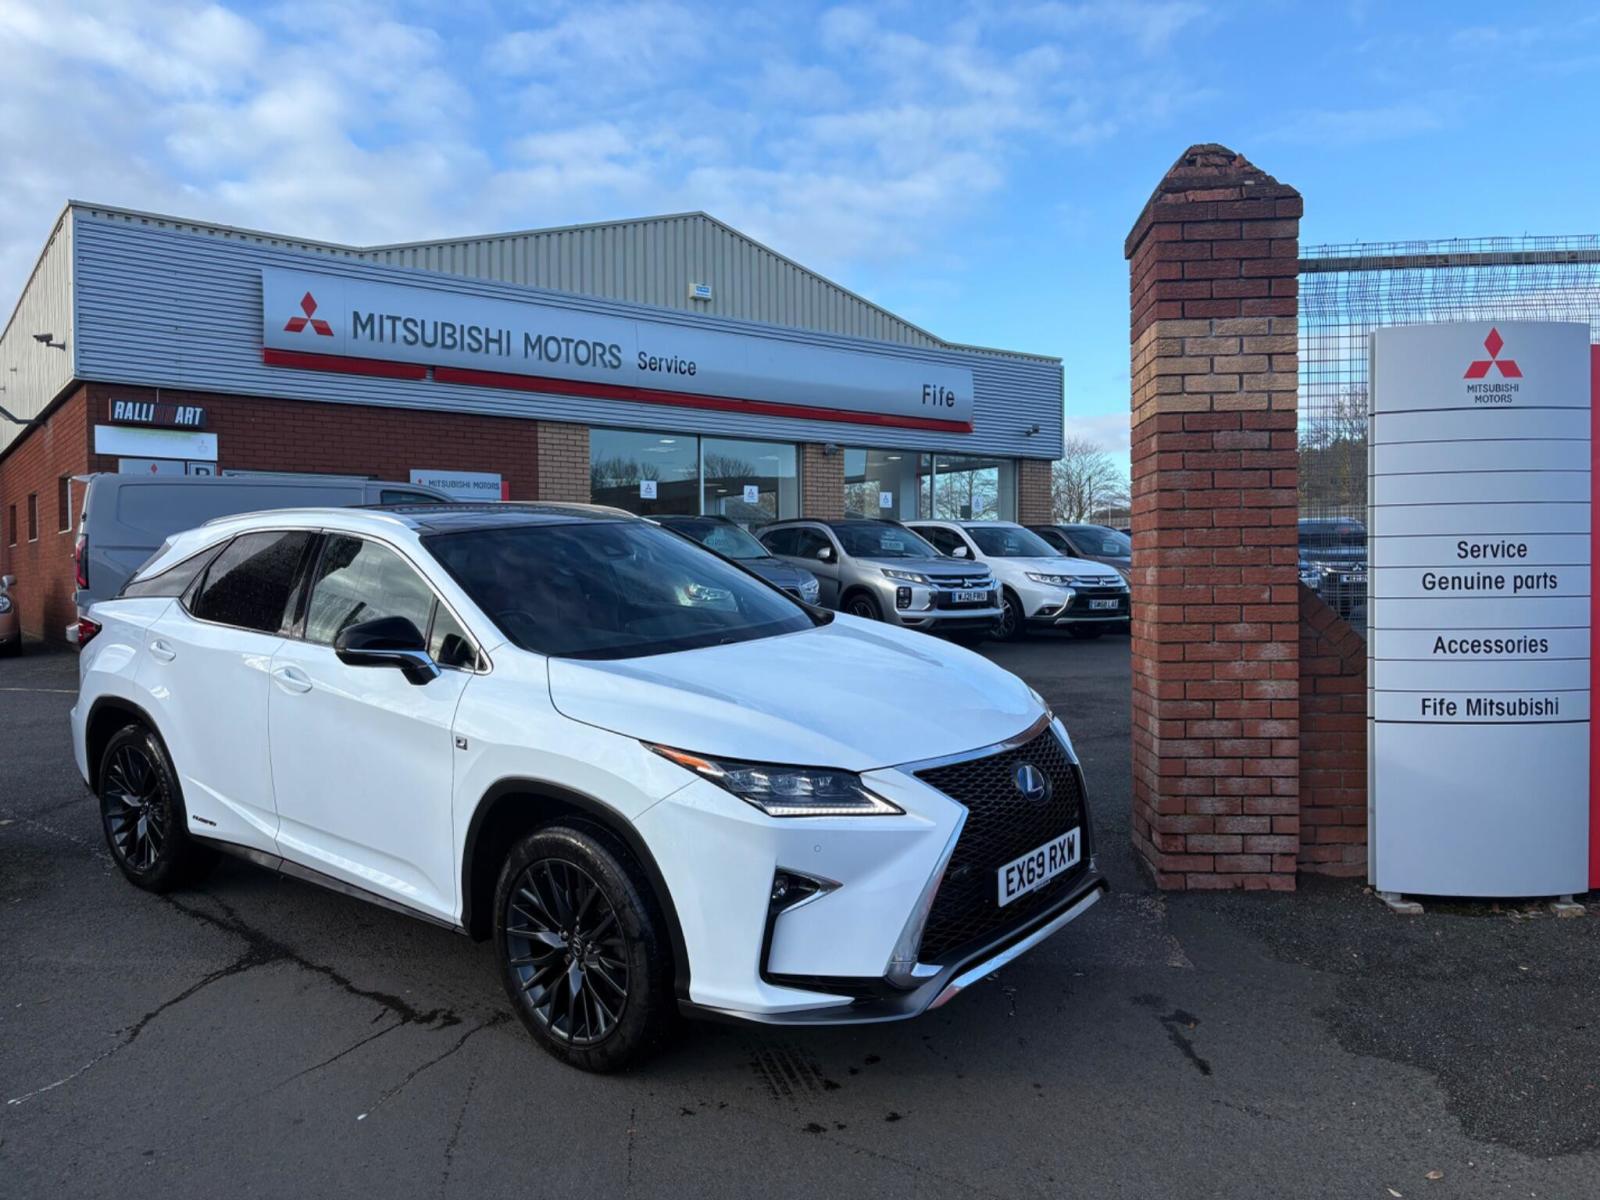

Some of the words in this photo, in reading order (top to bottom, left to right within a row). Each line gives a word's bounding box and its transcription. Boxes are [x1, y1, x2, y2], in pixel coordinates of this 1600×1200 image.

[351, 310, 511, 357] MITSUBISHI
[523, 332, 622, 369] MOTORS
[637, 351, 697, 376] Service
[922, 384, 955, 407] Fife
[1466, 383, 1519, 393] MITSUBISHI
[1474, 394, 1512, 403] MOTORS
[113, 400, 154, 421] RALLI
[174, 406, 203, 425] ART
[428, 479, 471, 488] MITSUBISHI
[473, 482, 500, 490] MOTORS
[1456, 540, 1528, 559] Service
[1421, 572, 1505, 591] Genuine
[1513, 572, 1558, 593] parts
[1432, 635, 1549, 654] Accessories
[1421, 697, 1457, 716] Fife
[1466, 697, 1559, 716] Mitsubishi
[1005, 850, 1045, 898] EX69
[1049, 833, 1075, 873] RXW
